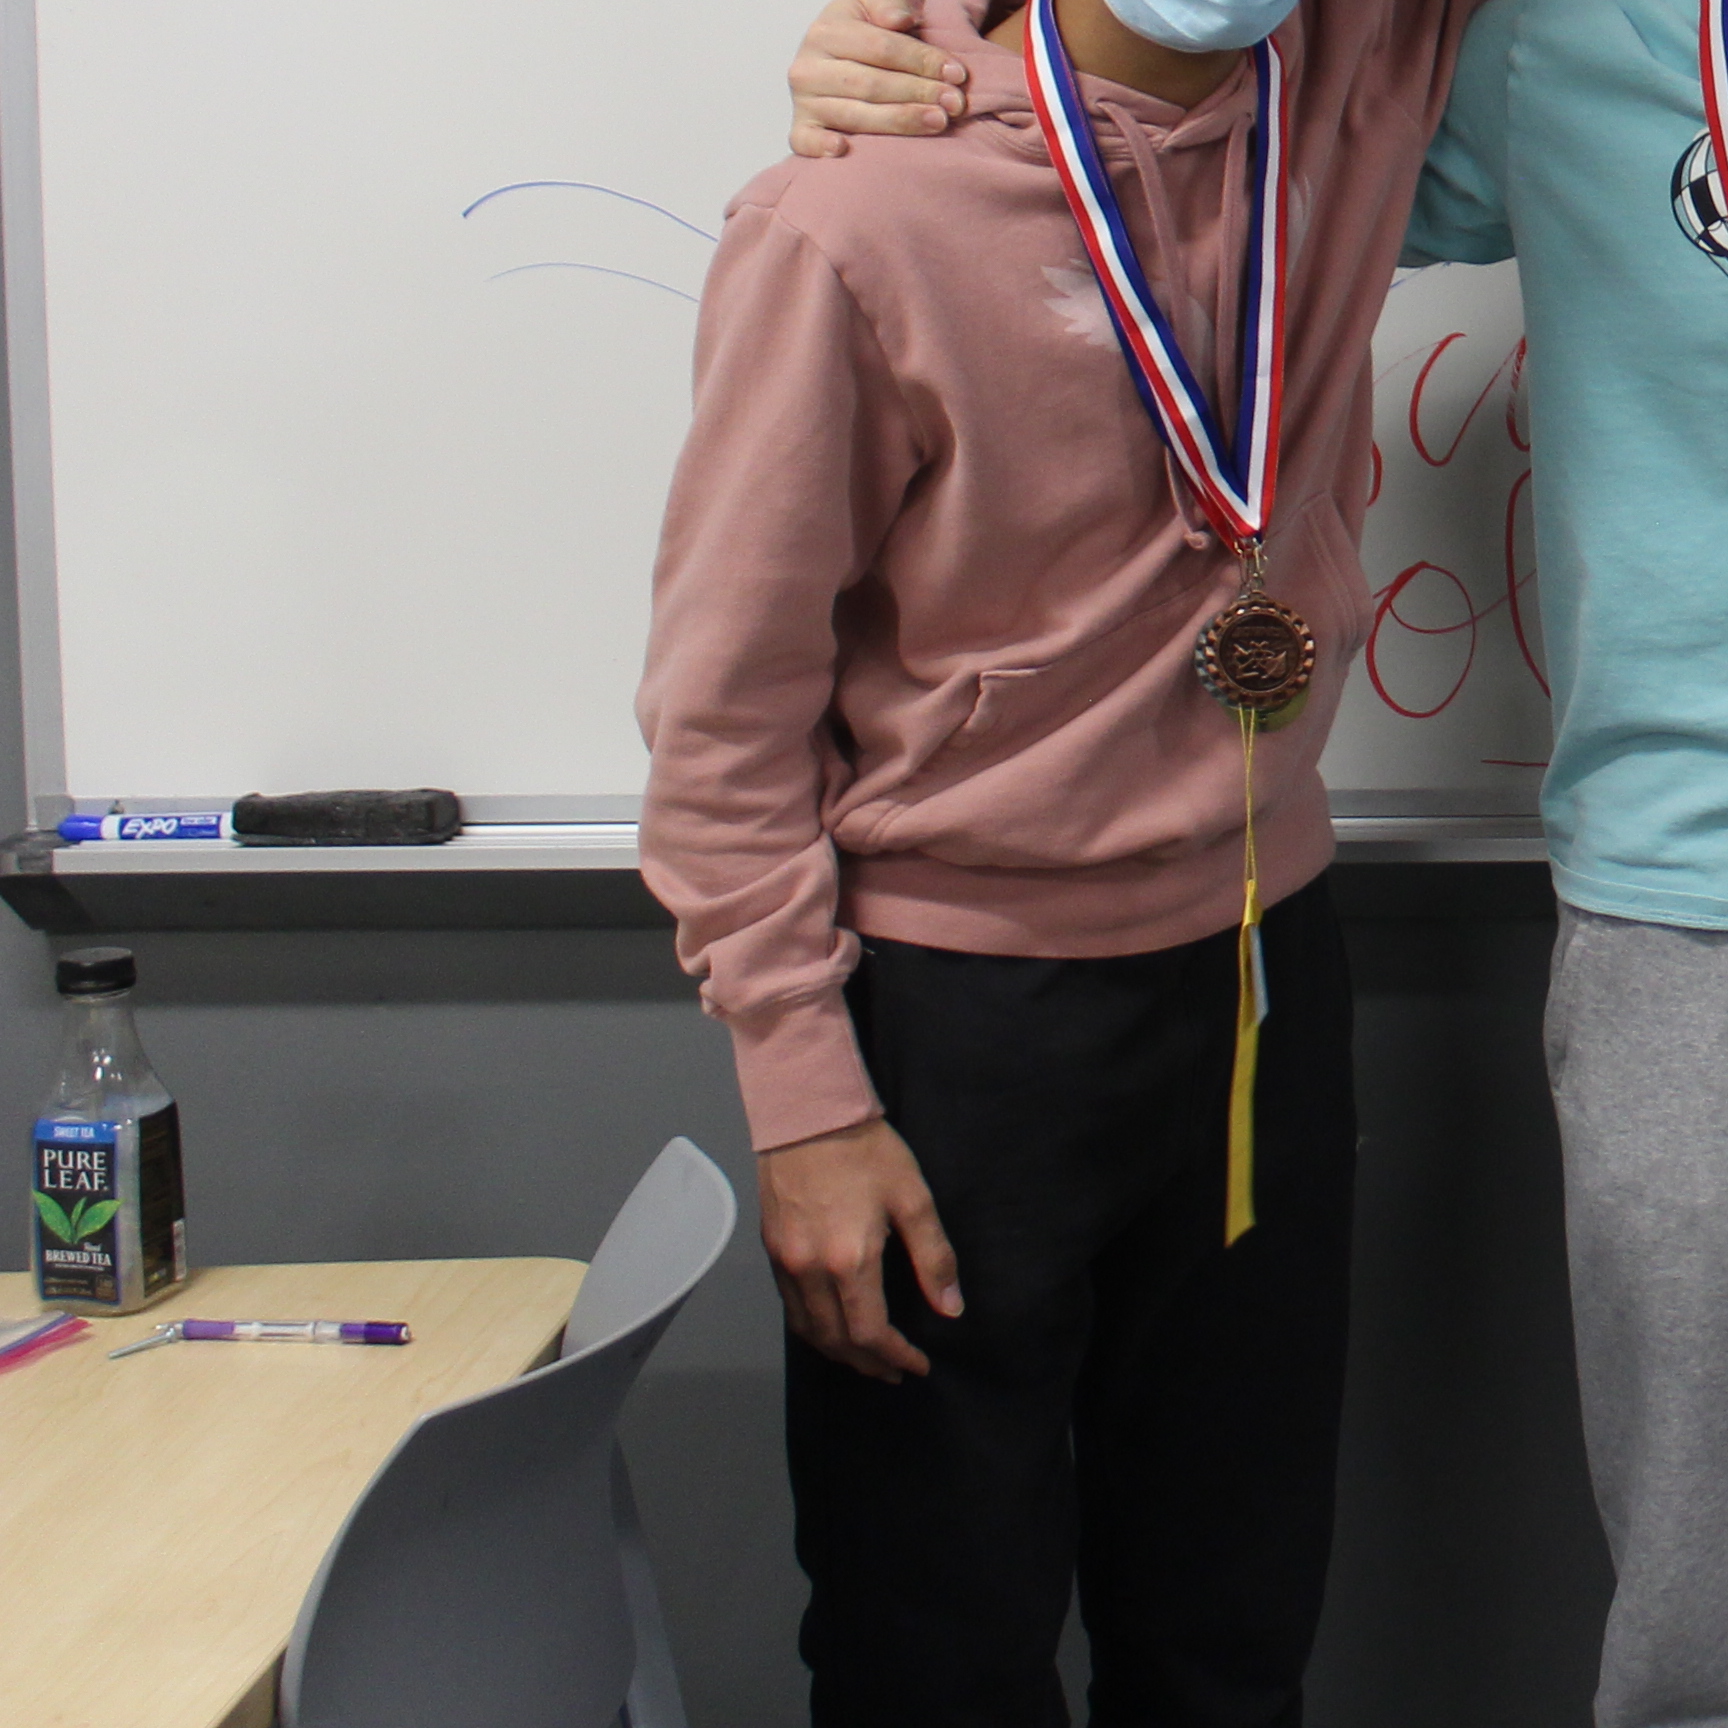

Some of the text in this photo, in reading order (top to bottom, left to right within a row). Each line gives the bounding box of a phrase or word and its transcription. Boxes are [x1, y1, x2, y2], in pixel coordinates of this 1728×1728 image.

[121, 817, 178, 839] EXPO
[43, 1148, 107, 1171] PURE
[45, 1249, 112, 1266] BREWED TEA
